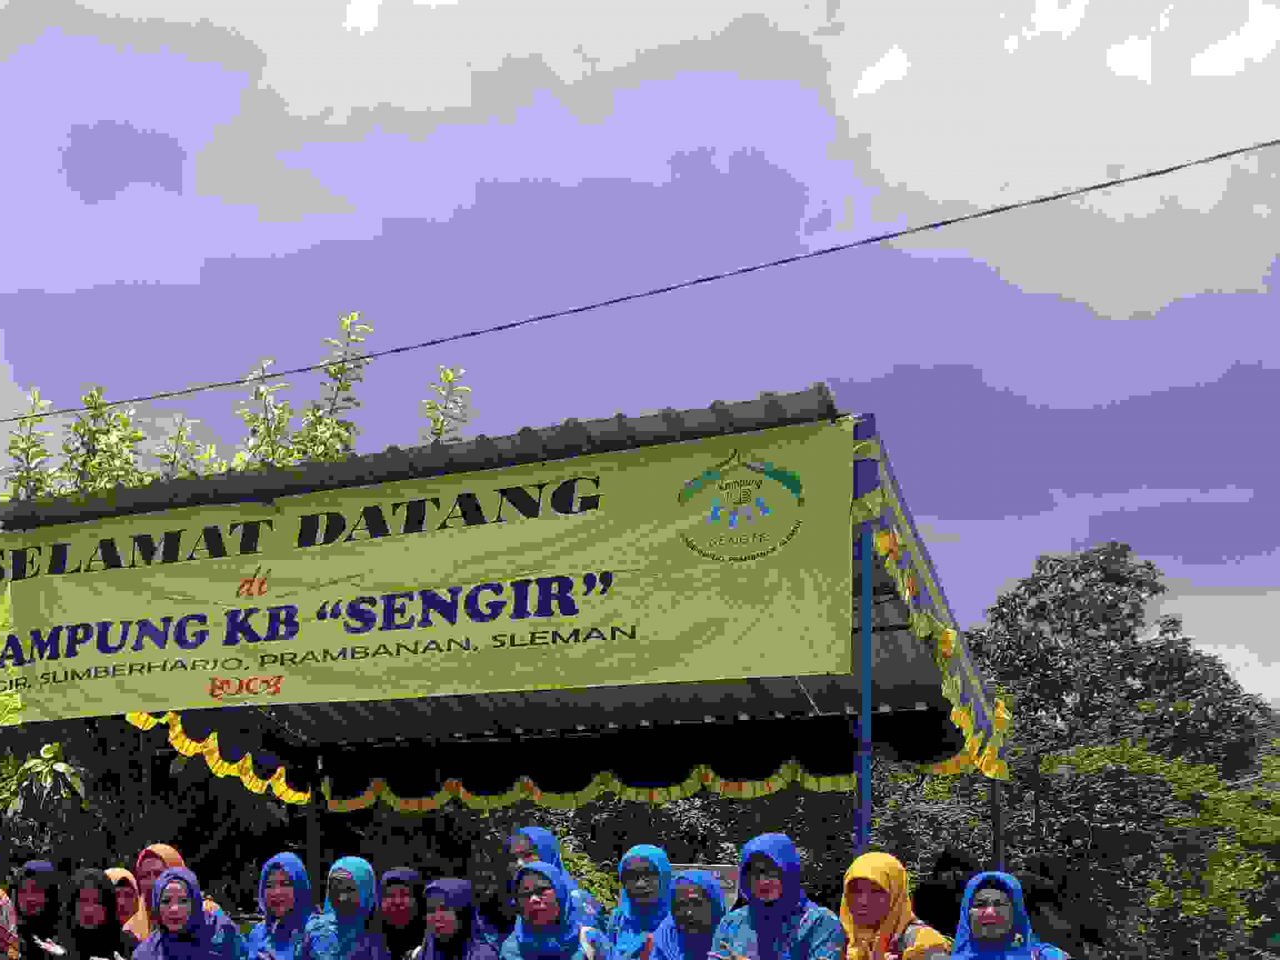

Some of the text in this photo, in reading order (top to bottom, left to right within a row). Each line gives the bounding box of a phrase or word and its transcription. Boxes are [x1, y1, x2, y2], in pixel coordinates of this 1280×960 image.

[294, 475, 605, 549] DATANG
[223, 604, 300, 646] KB
[316, 571, 614, 634] “SENGIR”
[235, 564, 272, 600] di
[259, 636, 480, 668] PRAMBANAN,
[491, 625, 638, 649] SLEMAN
